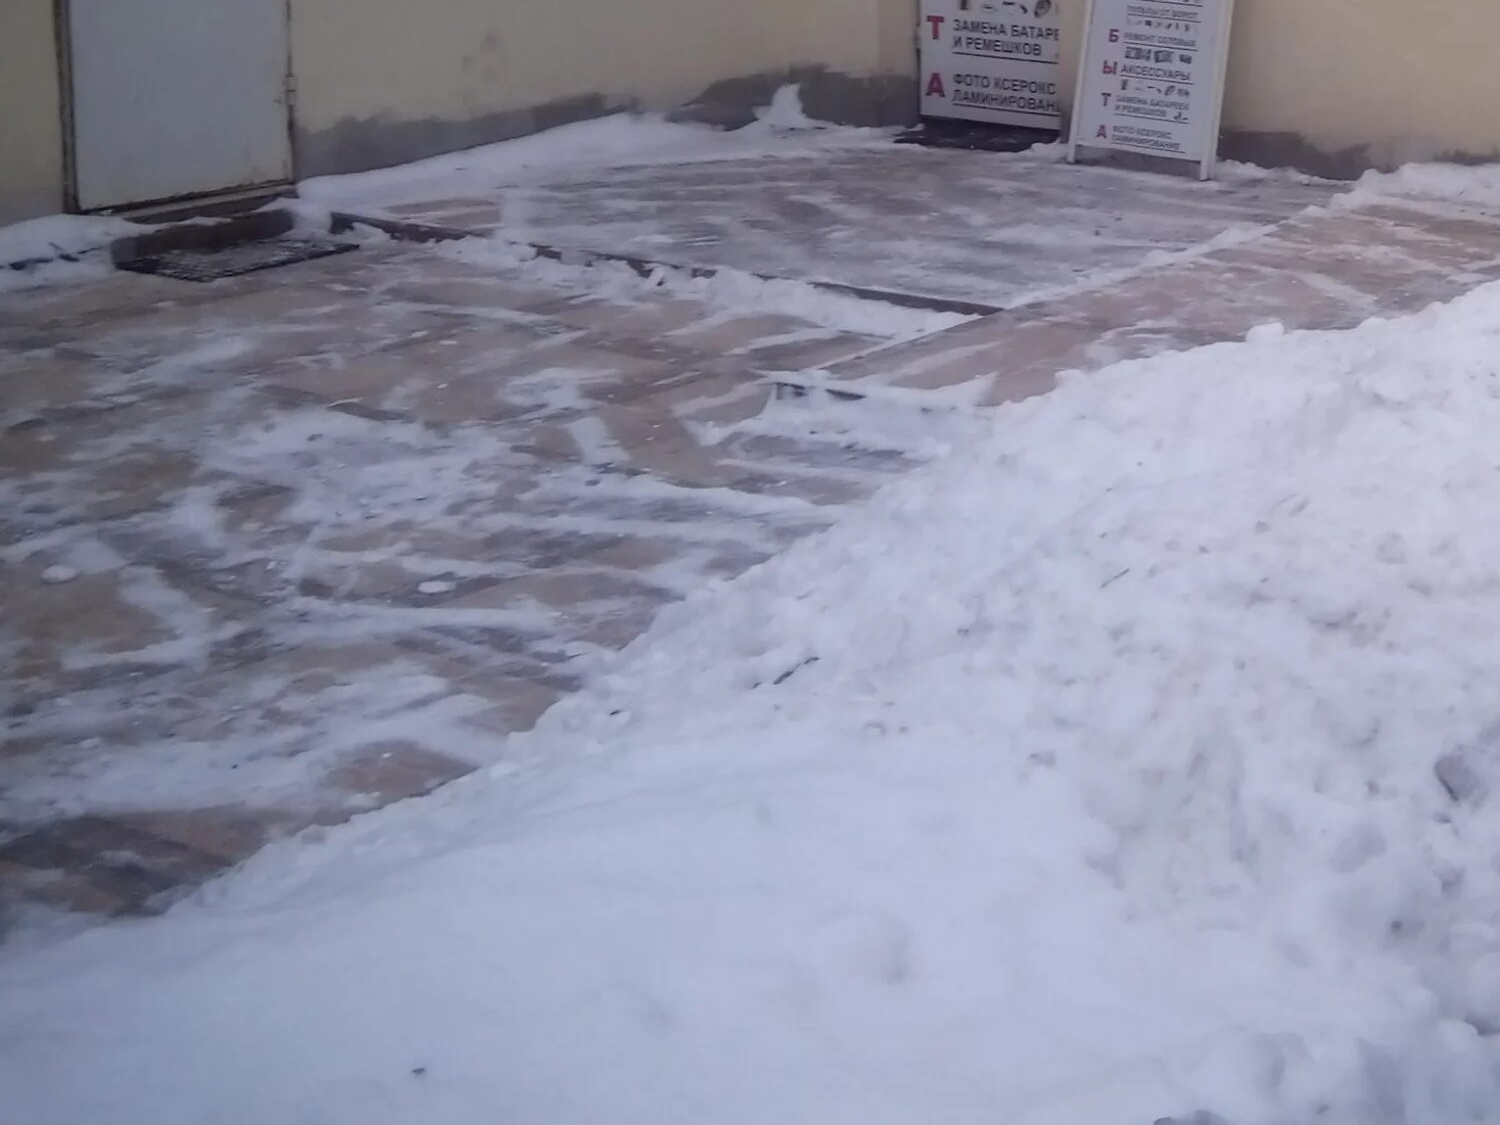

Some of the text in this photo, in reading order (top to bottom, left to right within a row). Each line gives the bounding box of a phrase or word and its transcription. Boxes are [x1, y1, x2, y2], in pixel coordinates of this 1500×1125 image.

[953, 19, 1007, 36] ЗАМЕНА
[953, 36, 1042, 56] И РЕМЕШКОВ
[953, 74, 1057, 95] ФОТО КСЕРОКС
